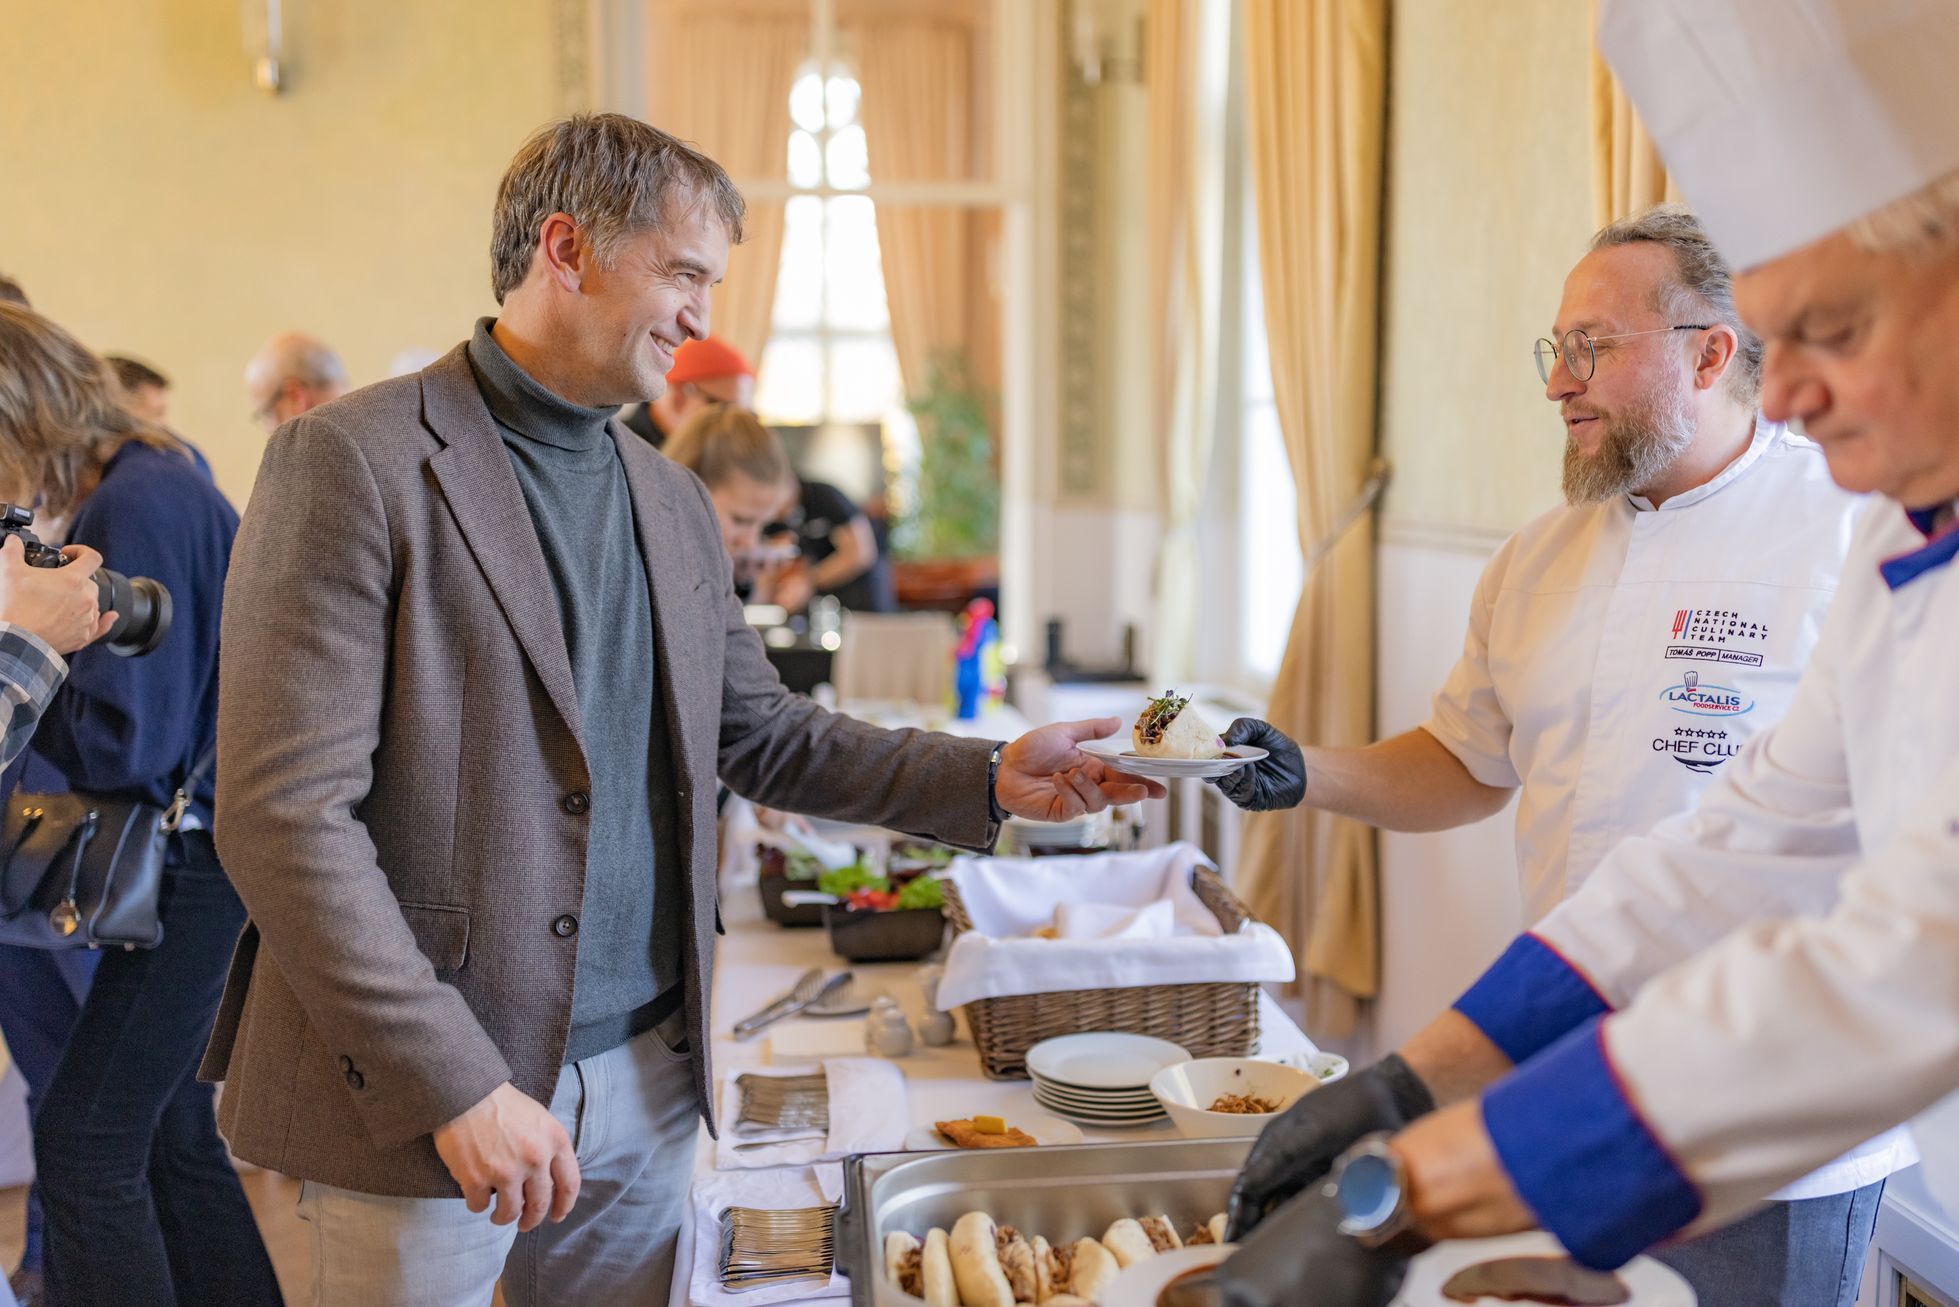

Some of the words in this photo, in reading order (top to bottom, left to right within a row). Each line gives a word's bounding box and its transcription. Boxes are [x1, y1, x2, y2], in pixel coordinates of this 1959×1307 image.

[1696, 610, 1738, 618] CZECH
[1694, 618, 1768, 631] NATIONAL
[1690, 634, 1726, 643] TEAM
[1692, 626, 1767, 640] CULINARY
[1669, 648, 1694, 657] TOMÁŠ
[1696, 650, 1717, 658] POPP
[1721, 653, 1759, 664] MANAGER
[1693, 702, 1731, 711] FOODSERVICE
[1652, 738, 1699, 753] CHEF
[1703, 742, 1743, 756] CLU
